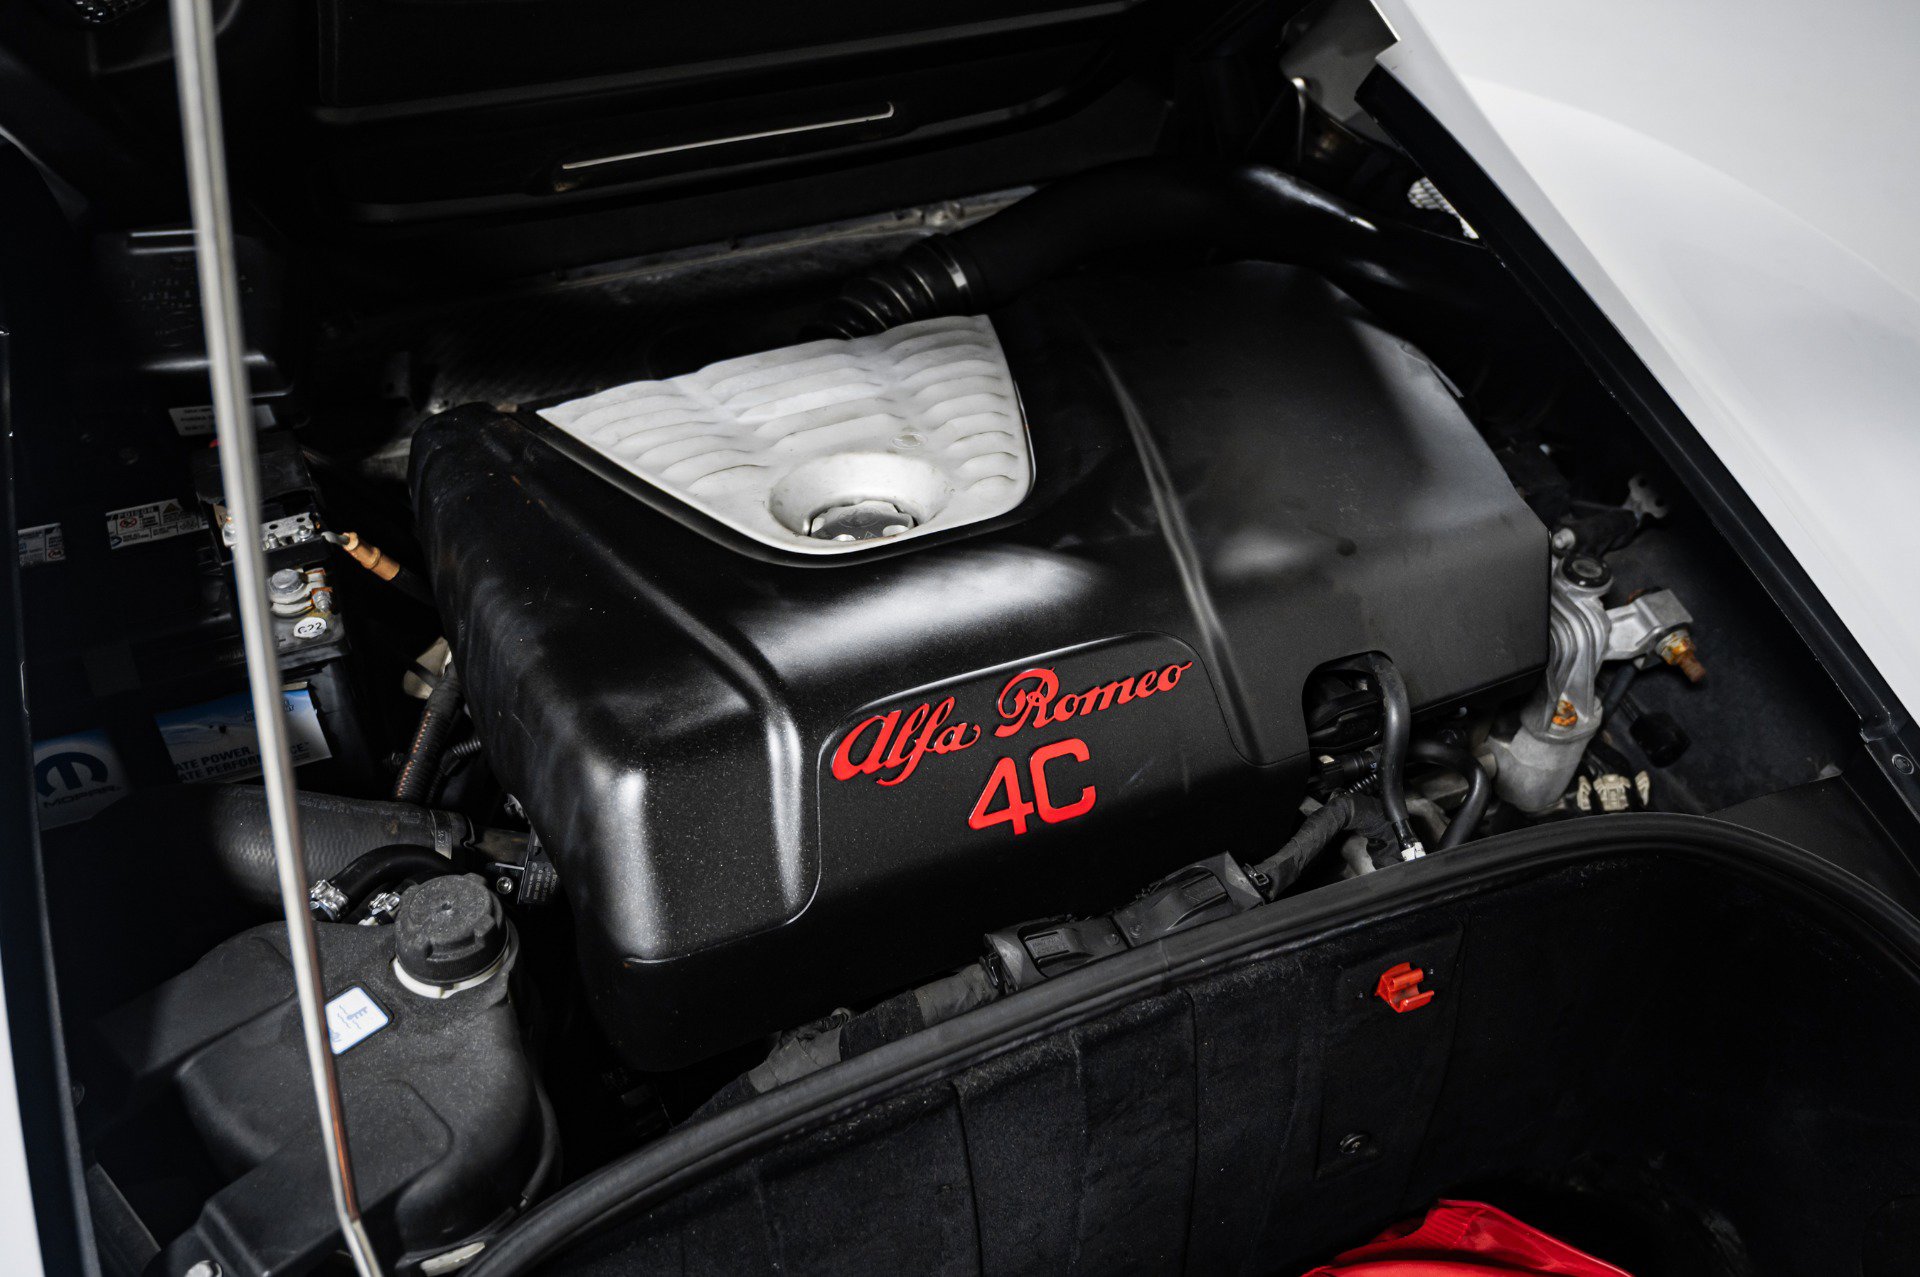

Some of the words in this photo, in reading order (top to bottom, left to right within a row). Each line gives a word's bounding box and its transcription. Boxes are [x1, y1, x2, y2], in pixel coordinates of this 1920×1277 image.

[206, 743, 304, 775] PERFORCE
[831, 696, 982, 787] Alfa
[994, 661, 1194, 738] Romeo
[968, 738, 1097, 836] 4C
